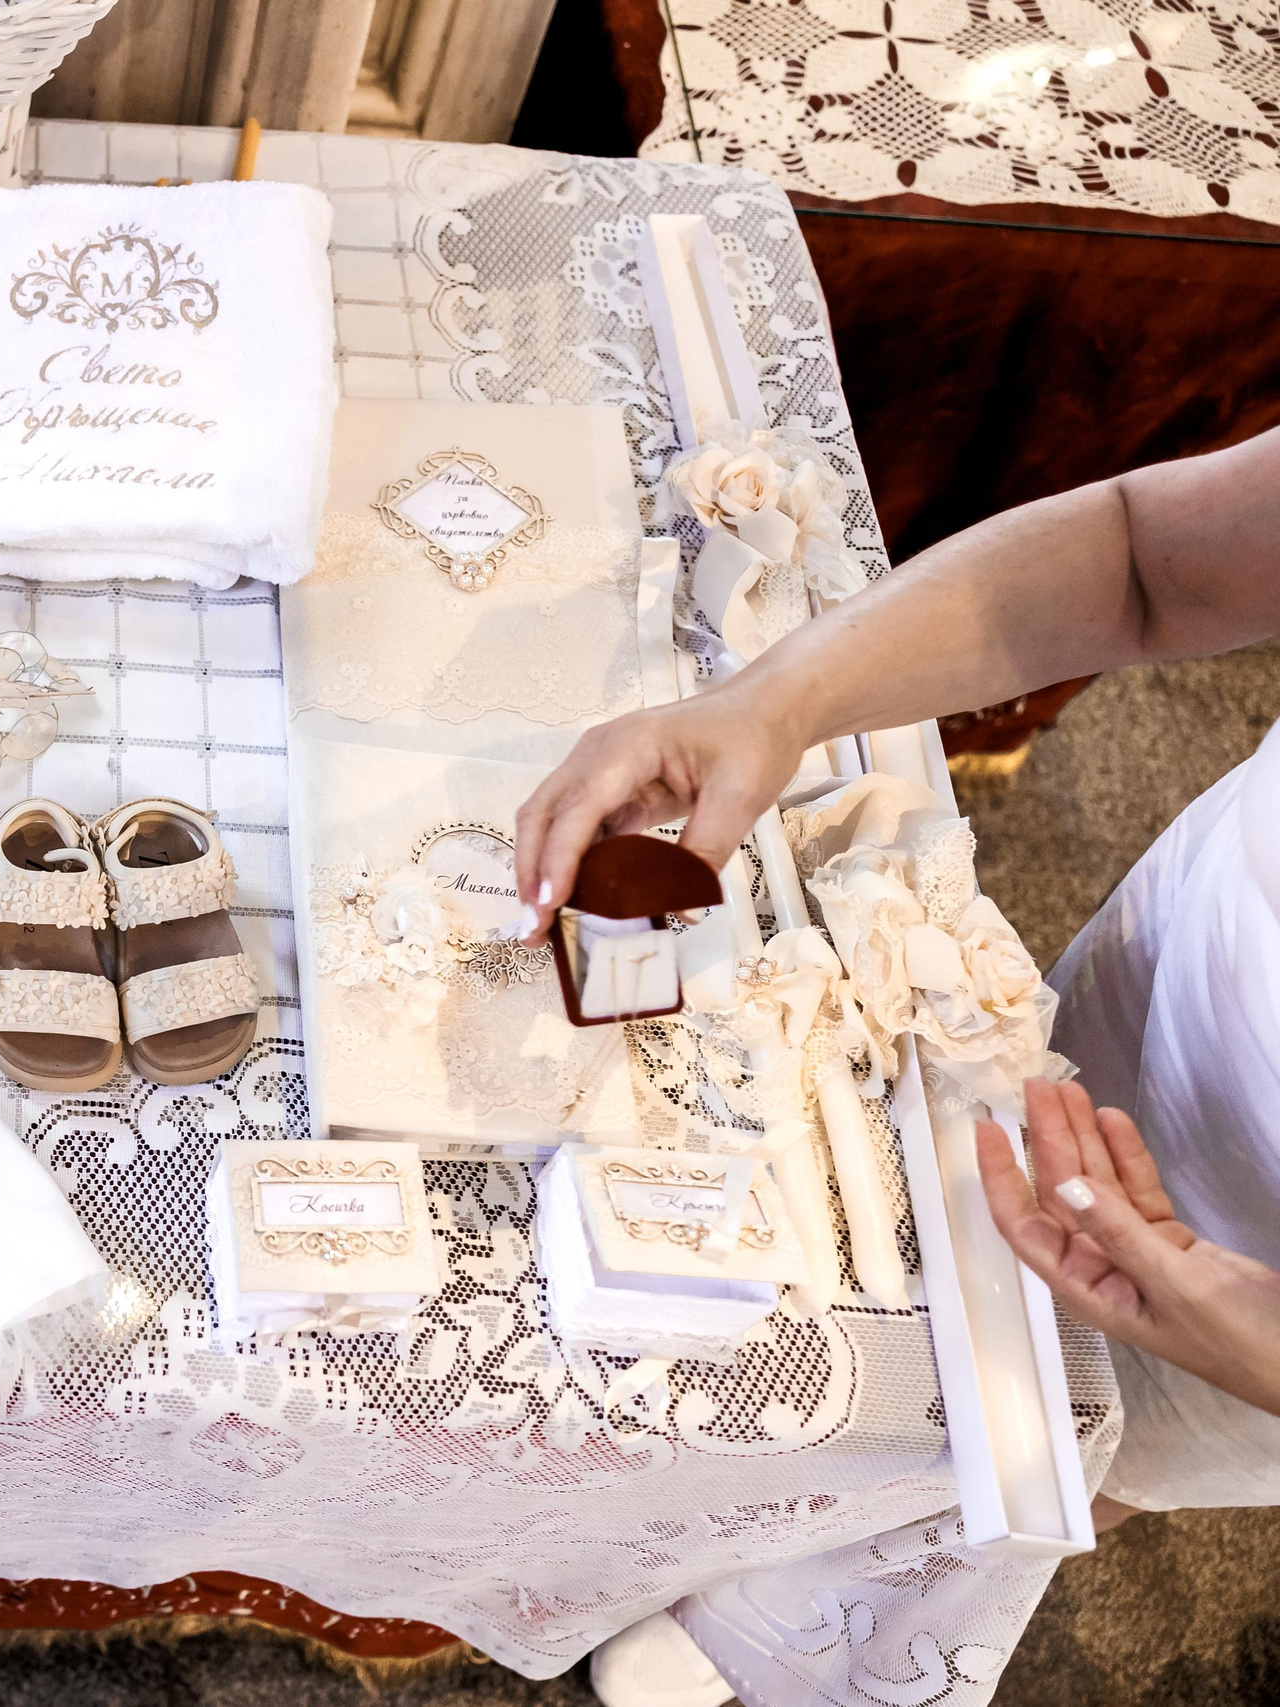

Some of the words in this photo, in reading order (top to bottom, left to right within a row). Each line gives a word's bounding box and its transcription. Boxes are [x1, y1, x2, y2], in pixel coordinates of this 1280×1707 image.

[38, 343, 183, 388] Свето
[435, 473, 483, 487] Папка
[454, 495, 469, 504] за
[441, 509, 489, 521] църковно
[429, 525, 505, 539] свидетелство
[433, 872, 518, 898] Михаела
[288, 1194, 365, 1213] Косичка
